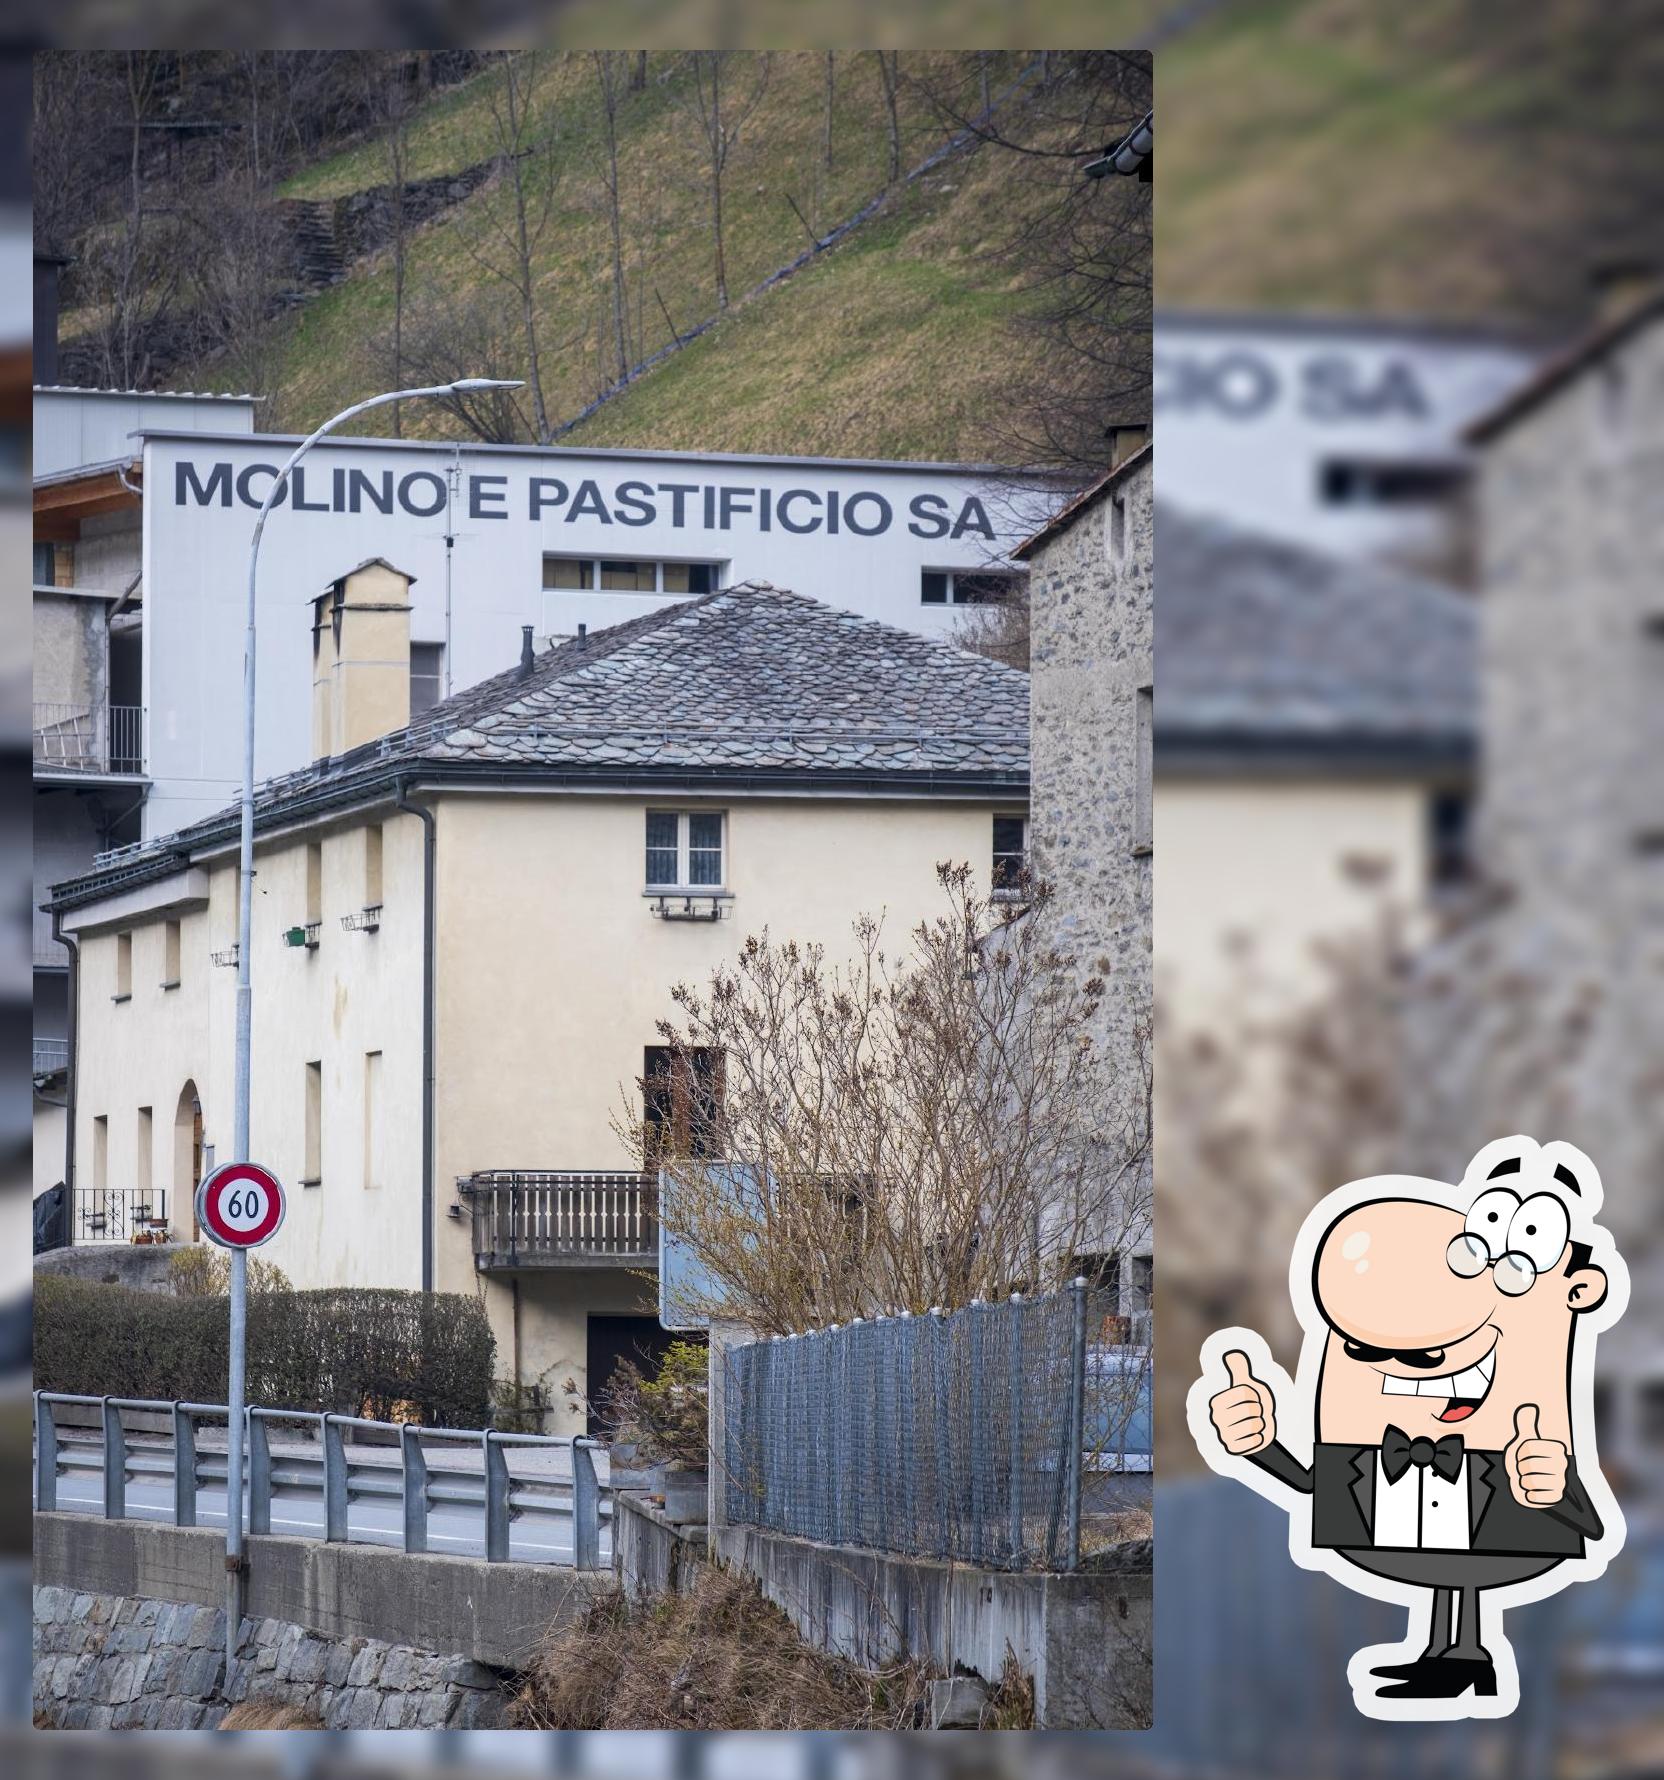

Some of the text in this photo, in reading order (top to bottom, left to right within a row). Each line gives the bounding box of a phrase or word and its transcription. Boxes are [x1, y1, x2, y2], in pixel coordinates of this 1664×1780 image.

[1303, 356, 1431, 424] SA
[175, 461, 996, 540] MOLINO E PASTIFICIO SA
[228, 1190, 259, 1218] 60
